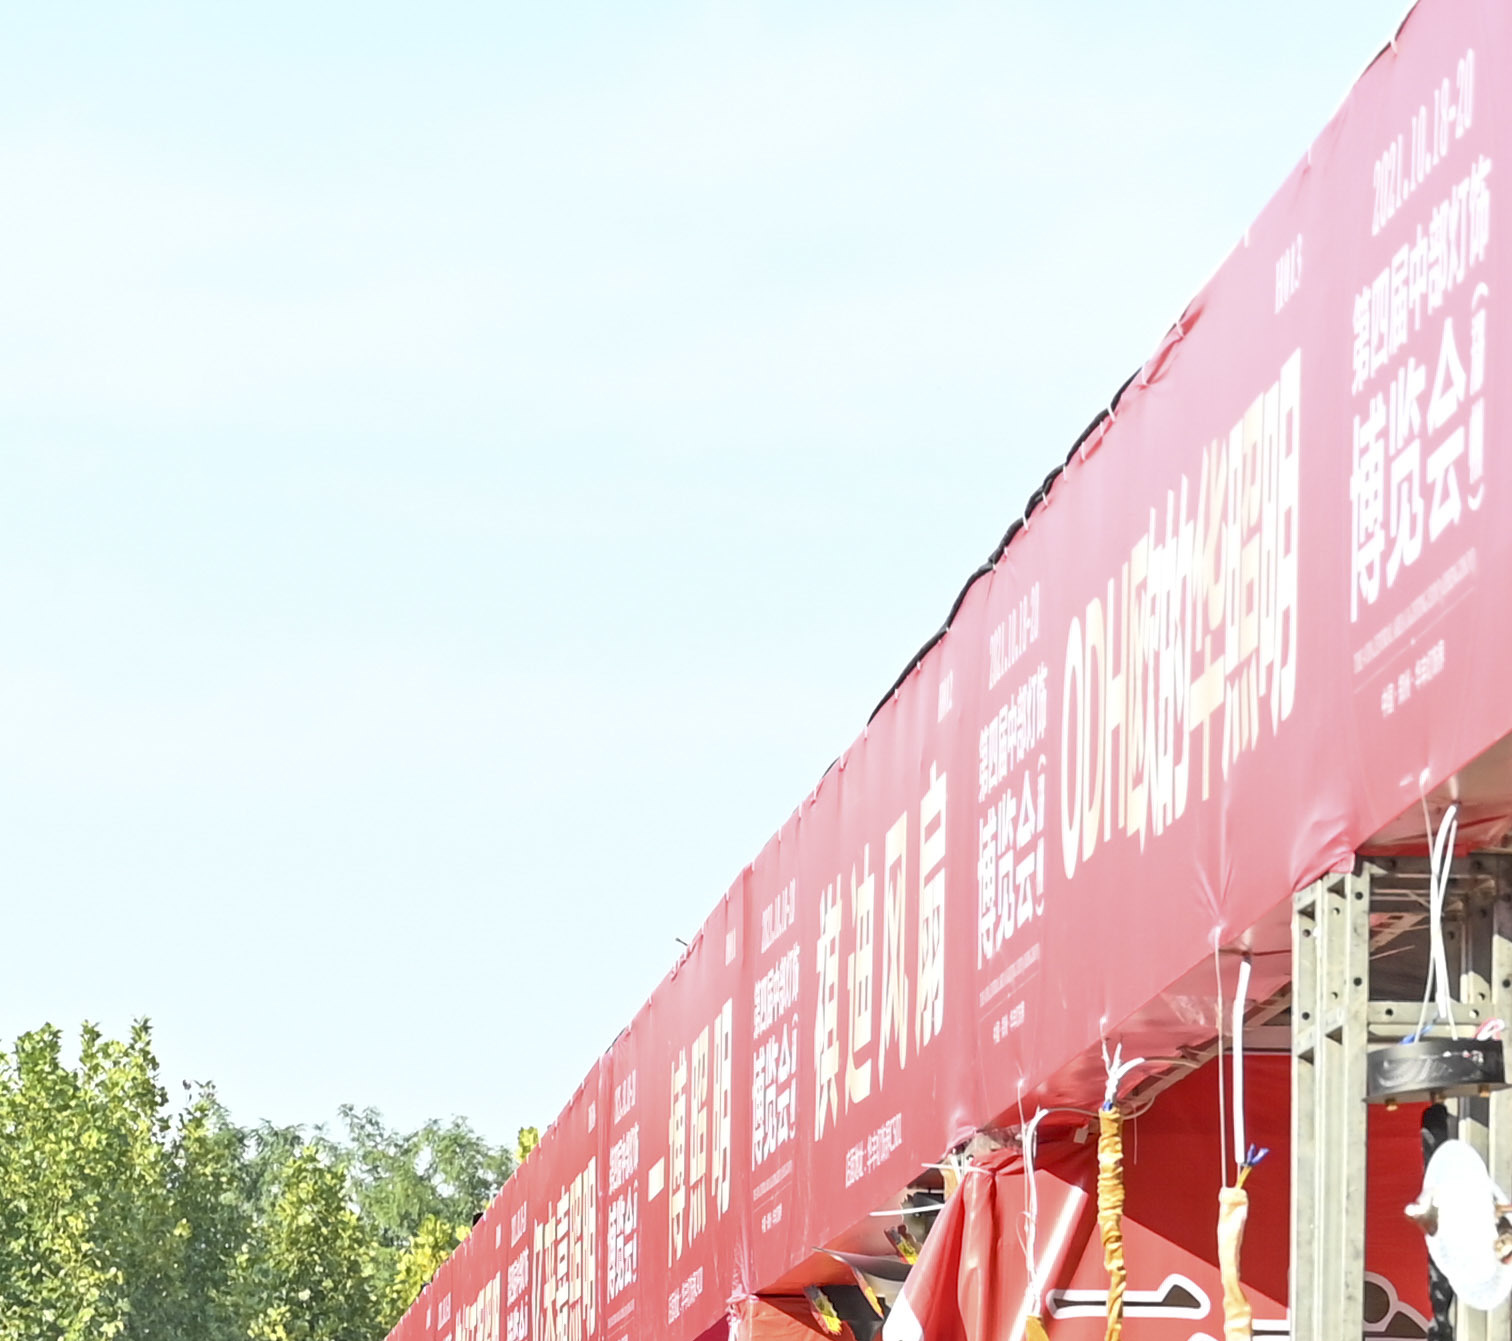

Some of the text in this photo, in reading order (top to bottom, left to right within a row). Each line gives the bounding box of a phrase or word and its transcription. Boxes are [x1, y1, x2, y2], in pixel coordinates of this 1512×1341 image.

[1373, 48, 1475, 235] 2021.10.18-20
[1352, 154, 1491, 396] 第四届中部灯饰
[1350, 317, 1466, 622] 博览会
[814, 762, 948, 1142] 祺迪风扇
[978, 771, 1037, 970] 博览会
[648, 997, 733, 1269] 一博照明
